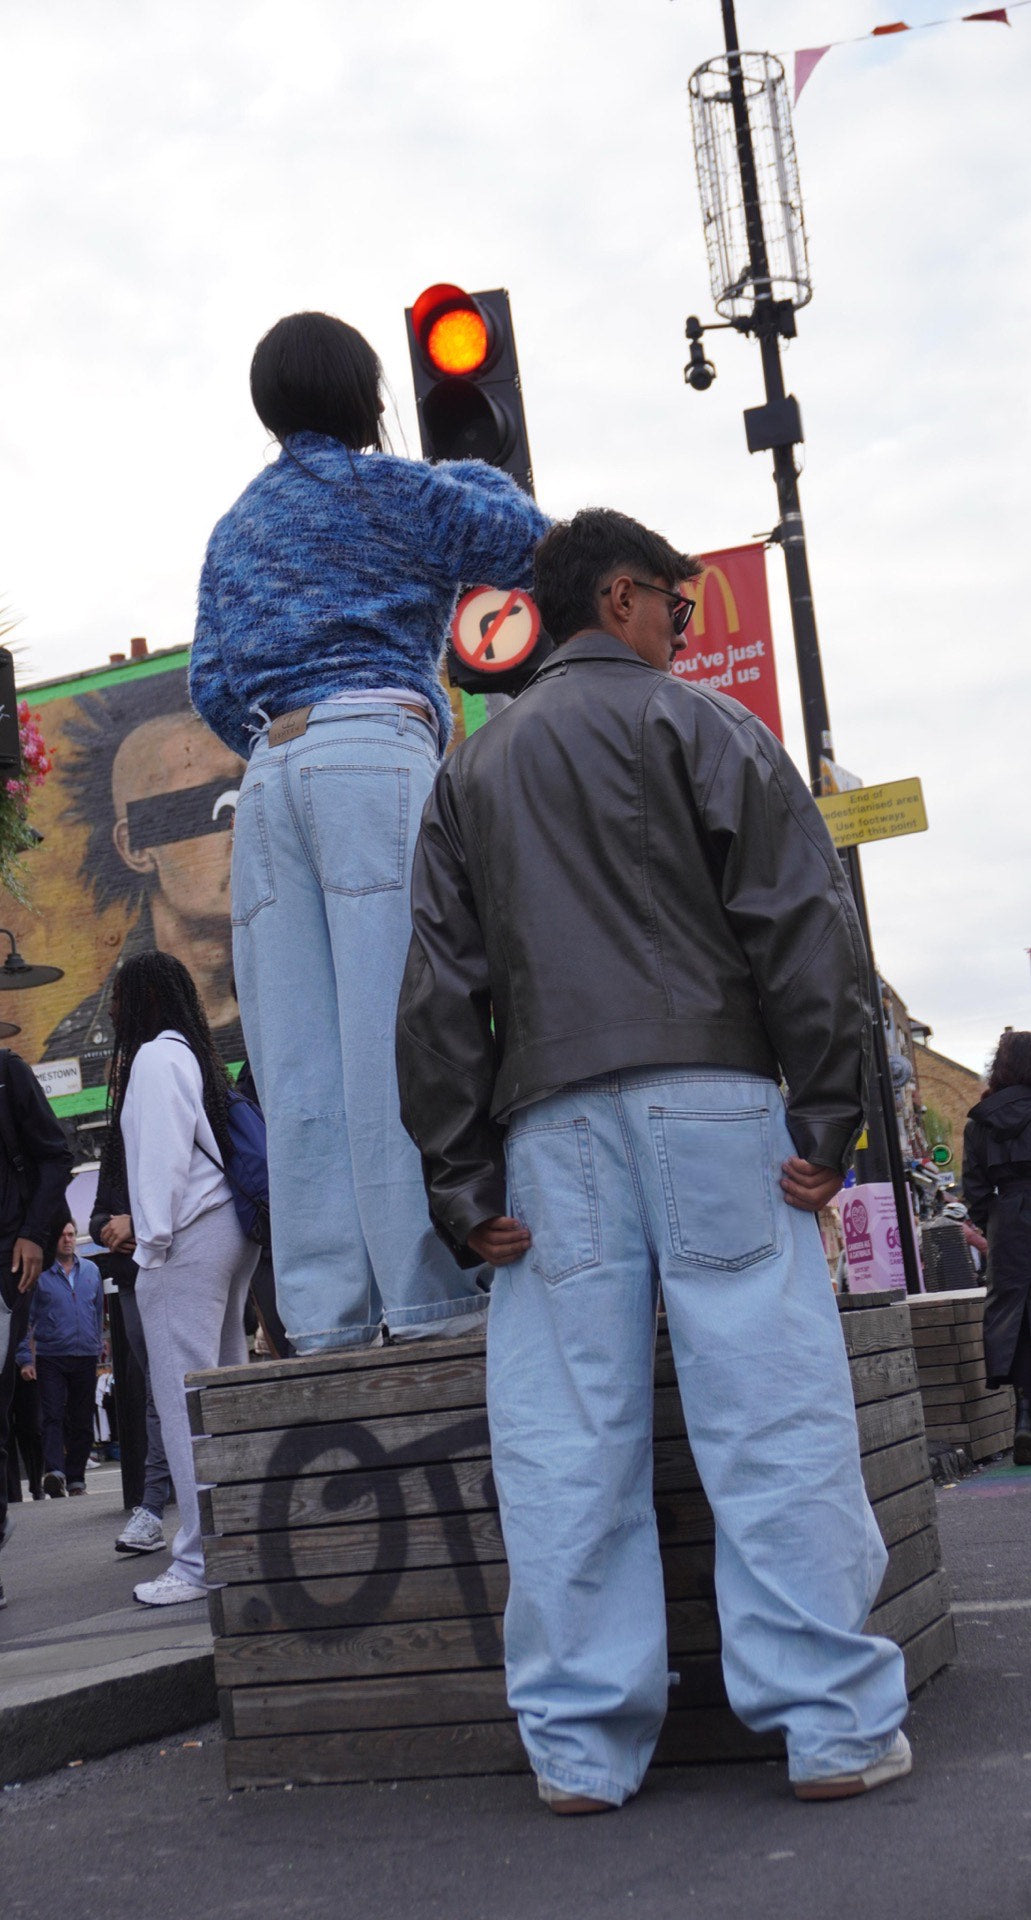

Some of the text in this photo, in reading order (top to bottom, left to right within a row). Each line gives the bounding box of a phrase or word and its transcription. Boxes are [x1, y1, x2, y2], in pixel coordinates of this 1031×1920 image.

[672, 640, 765, 675] ou've just
[737, 666, 761, 684] us
[850, 789, 883, 804] End of
[824, 795, 919, 820] edestrianised area
[836, 811, 906, 831] Use footways
[834, 820, 917, 843] eyond this point
[36, 1067, 78, 1081] MESTOWN
